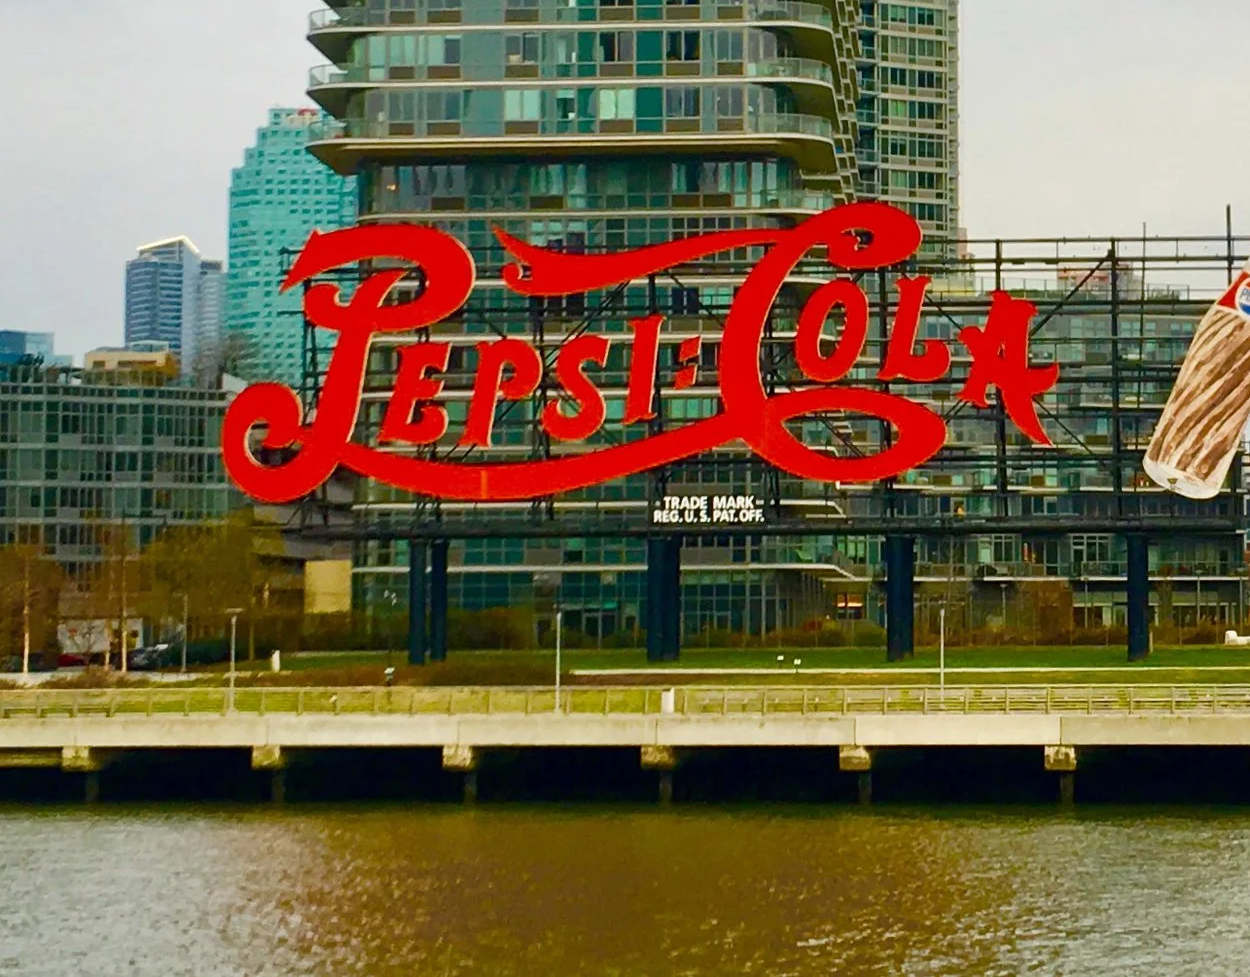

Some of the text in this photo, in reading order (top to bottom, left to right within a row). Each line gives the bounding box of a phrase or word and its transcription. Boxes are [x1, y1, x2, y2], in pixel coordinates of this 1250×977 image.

[662, 495, 755, 510] TRADE MARK
[653, 509, 683, 523] REG.
[712, 509, 738, 523] PAT.
[739, 509, 765, 523] OFF.
